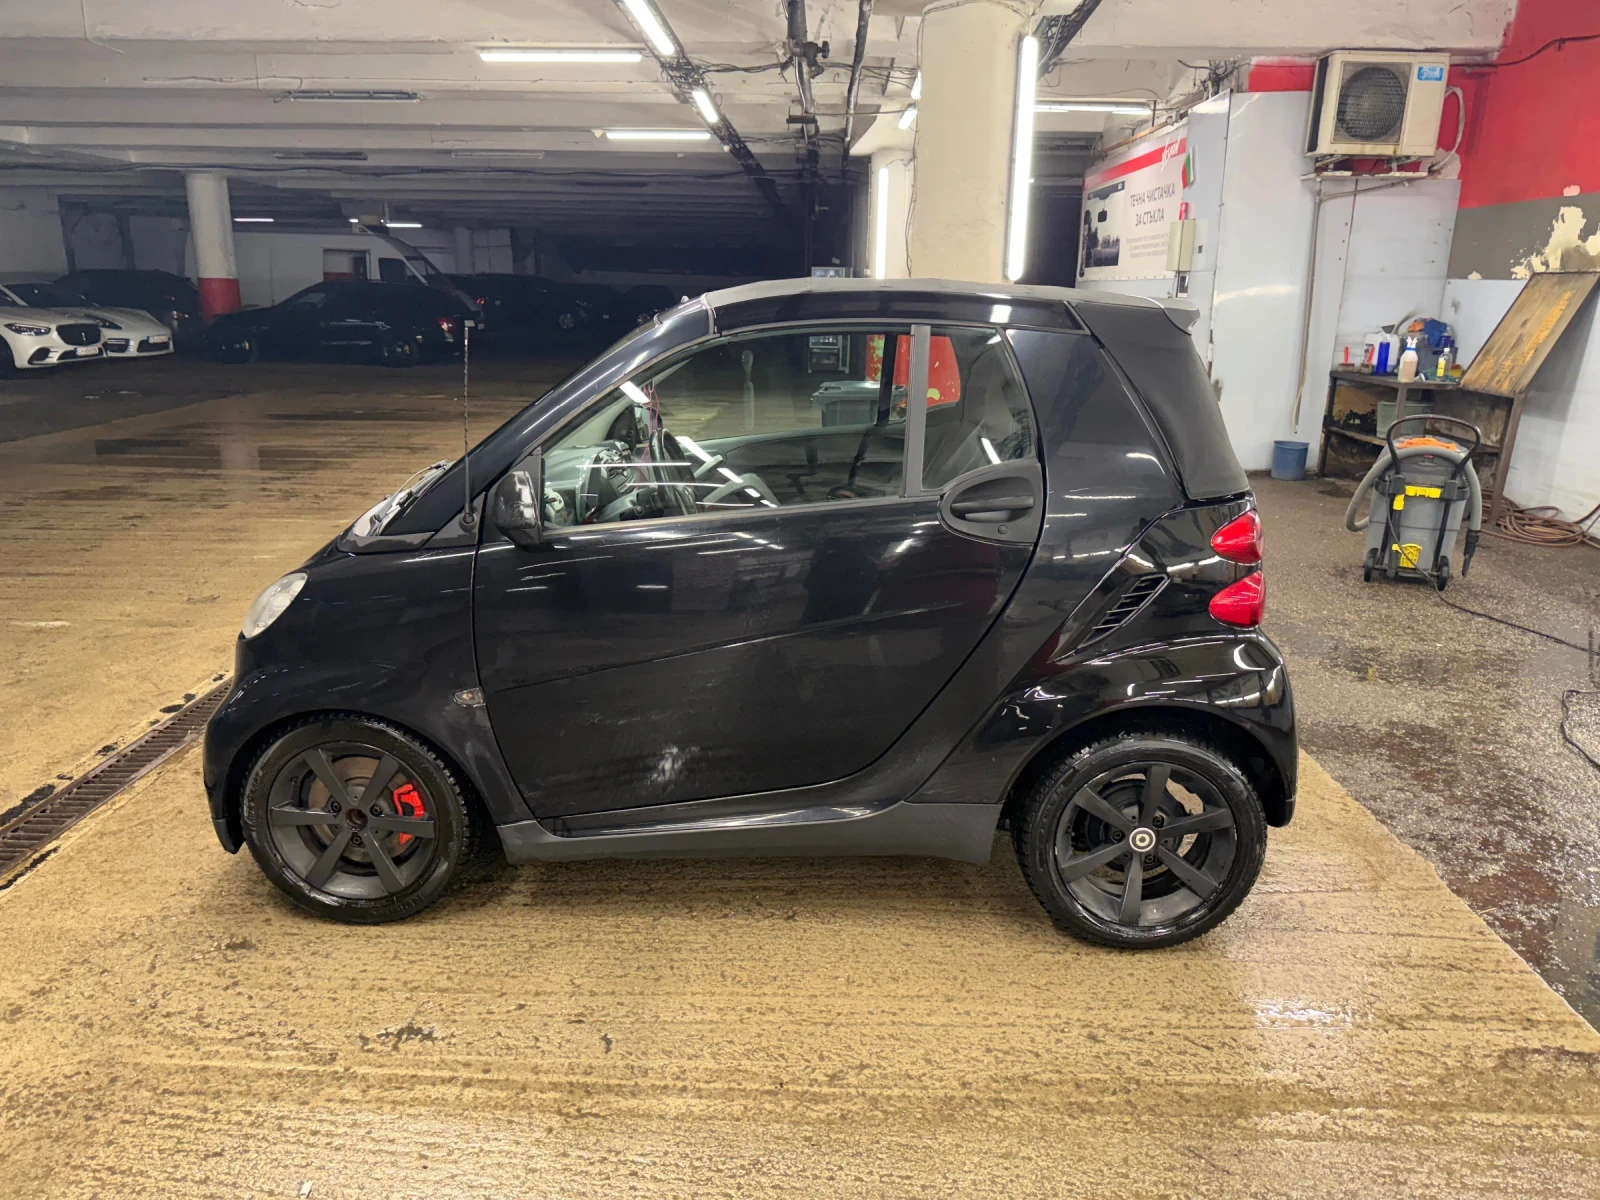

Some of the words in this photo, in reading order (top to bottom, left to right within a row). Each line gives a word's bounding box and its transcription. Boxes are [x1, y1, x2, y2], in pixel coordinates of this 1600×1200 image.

[1147, 182, 1176, 203] ЧИСТАЧКА
[1135, 213, 1142, 227] ЗА
[1142, 208, 1165, 225] СТЪКЛА
